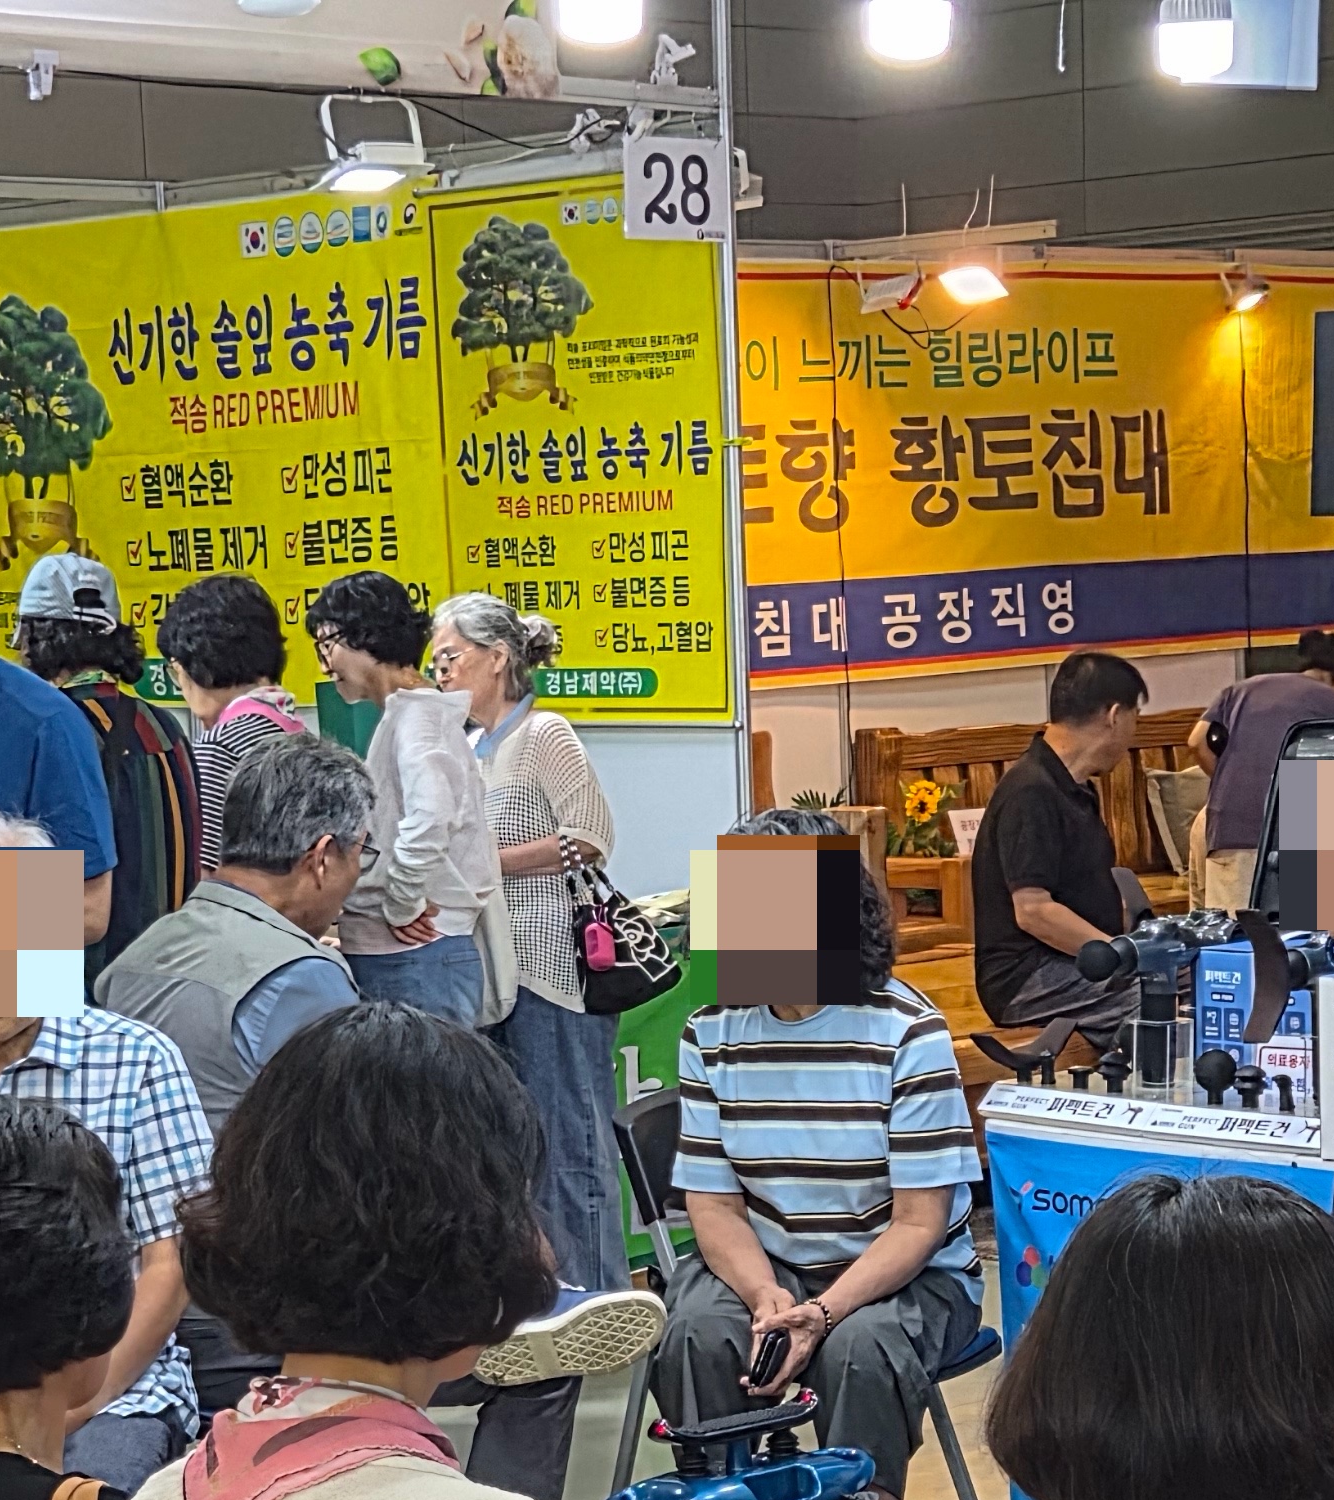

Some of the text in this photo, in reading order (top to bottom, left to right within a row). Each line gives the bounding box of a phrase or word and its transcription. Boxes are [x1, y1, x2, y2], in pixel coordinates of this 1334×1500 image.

[642, 152, 712, 228] 28
[107, 275, 428, 387] 신기한 솔잎 농축 기름
[798, 334, 911, 388] 느끼는
[928, 328, 1119, 388] 힐링라이프
[168, 381, 361, 436] 적송 RED PREMIUM
[302, 446, 393, 500] 만성 피곤
[456, 419, 714, 487] 신기한 솔잎 농축 기름
[889, 408, 1171, 528] 황토침대
[140, 458, 234, 510] 혈액순환
[496, 489, 674, 519] 적송 RED PREMIUM
[147, 524, 269, 575] 노폐물 제거
[301, 514, 400, 566] 불면증 등
[483, 533, 557, 568] 혈액순환
[608, 529, 690, 564] 만성 피곤
[545, 579, 581, 611] 제거
[610, 575, 691, 609] 불면증 등
[881, 579, 1076, 650] 공장직영
[611, 620, 715, 656] 당뇨,고혈압
[545, 670, 643, 697] 경남제약(주)
[1267, 1052, 1311, 1069] 의료용자
[1046, 1096, 1116, 1120] 퍼펙트건
[1216, 1116, 1291, 1139] 퍼펙트건
[1031, 1188, 1094, 1218] som
